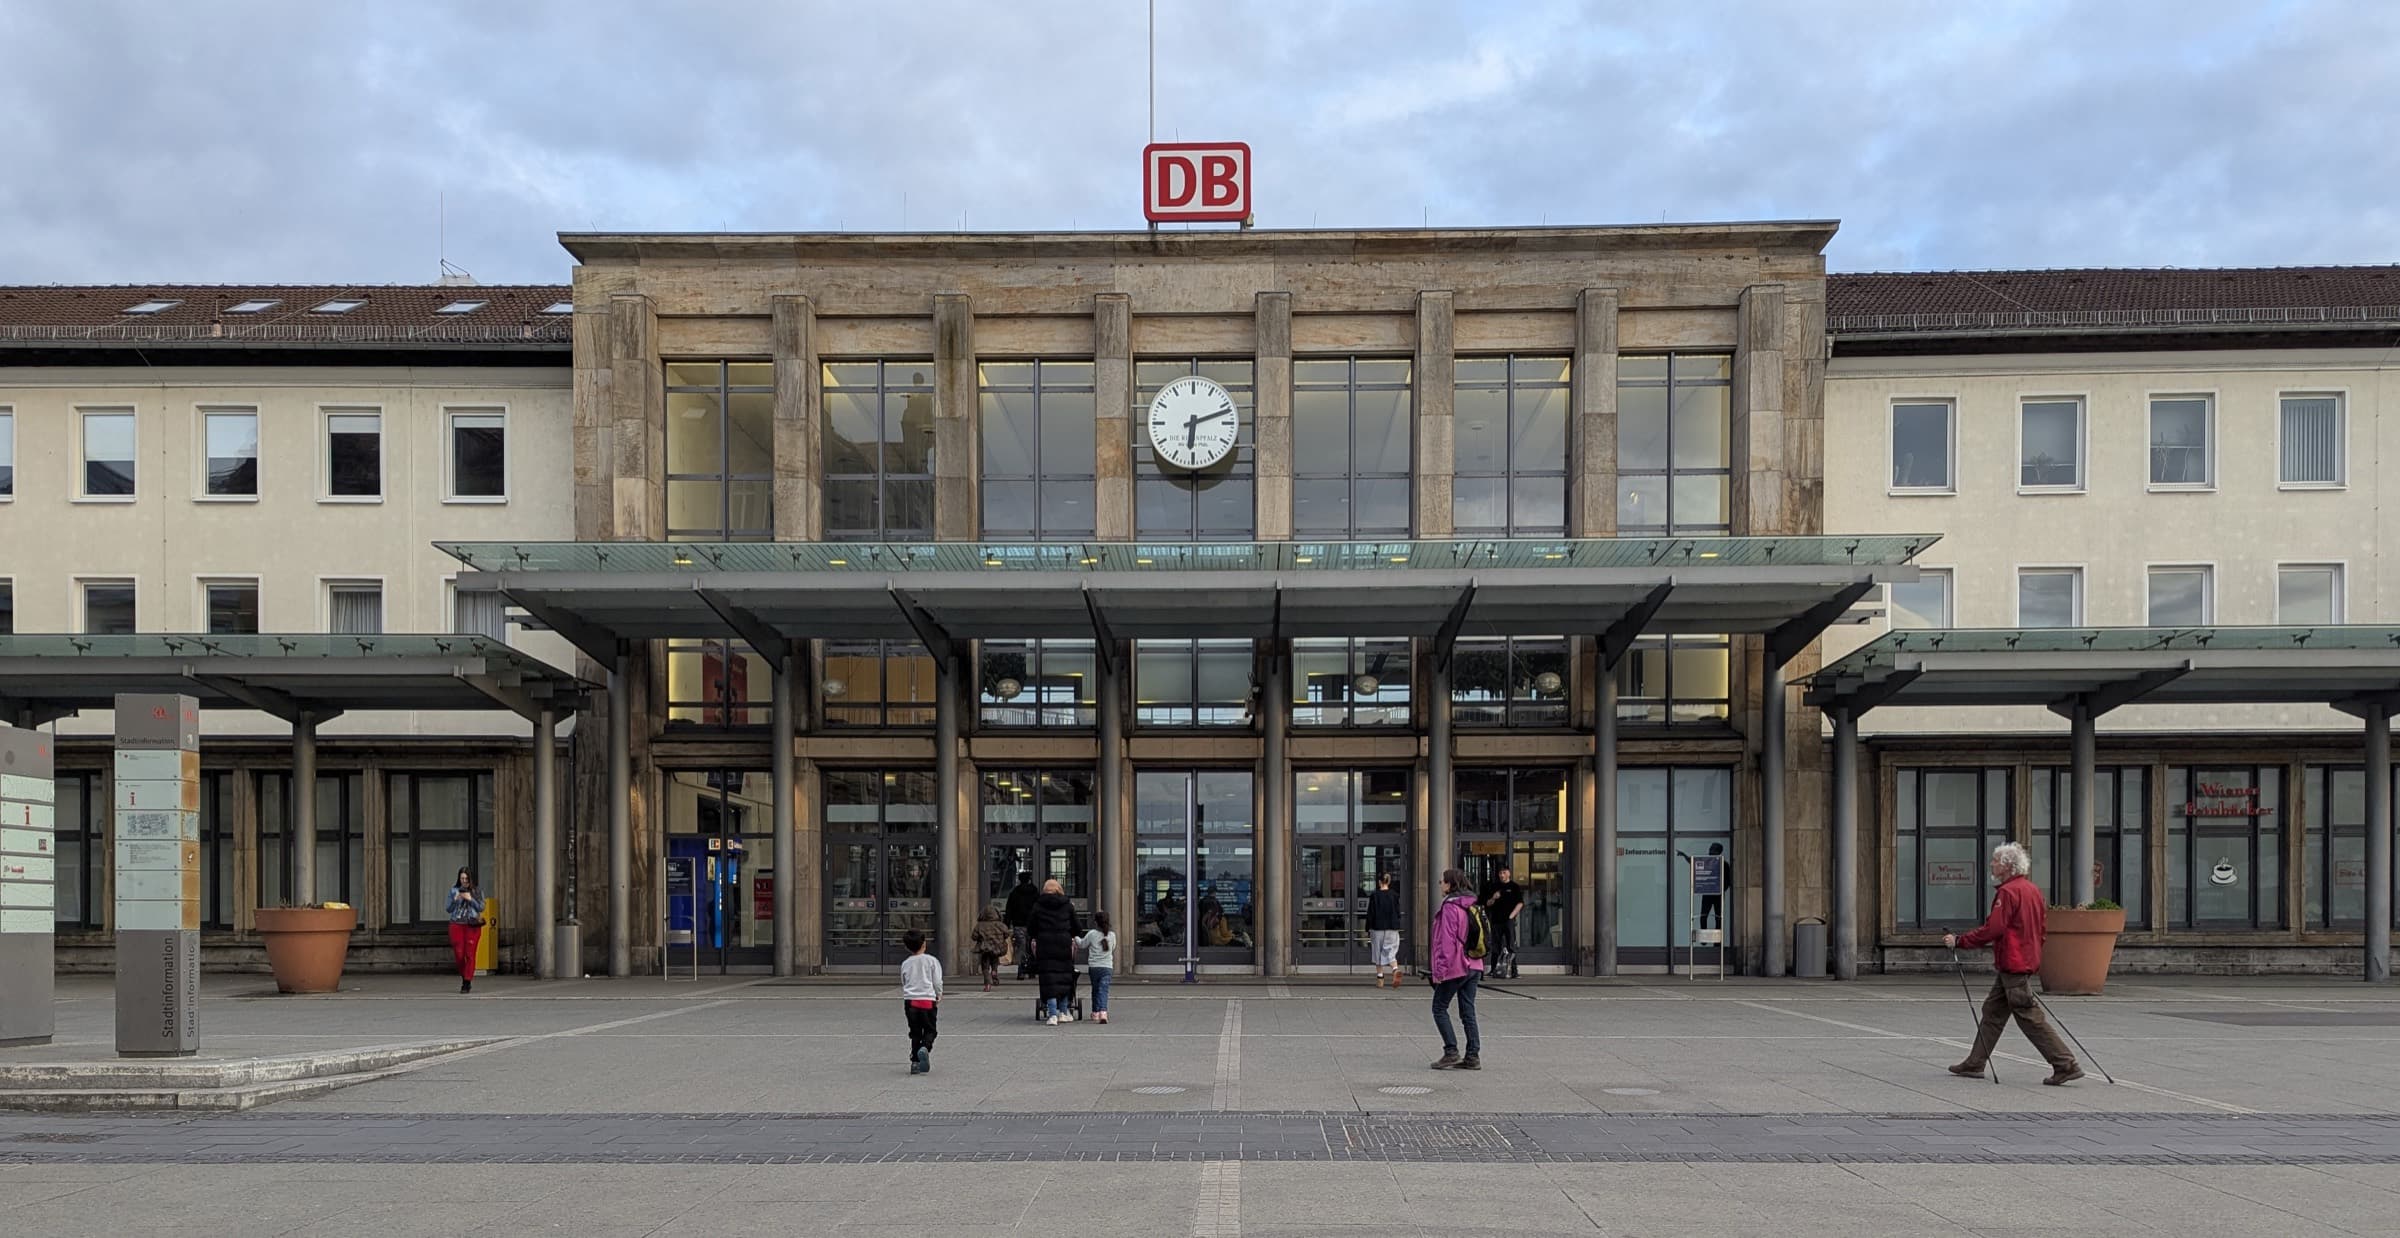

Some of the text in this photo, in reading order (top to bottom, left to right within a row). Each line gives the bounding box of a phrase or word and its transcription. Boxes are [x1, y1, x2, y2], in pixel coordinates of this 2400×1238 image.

[1157, 155, 1240, 207] DB
[2201, 783, 2260, 796] Wiener
[162, 937, 174, 1038] Stadtinformation
